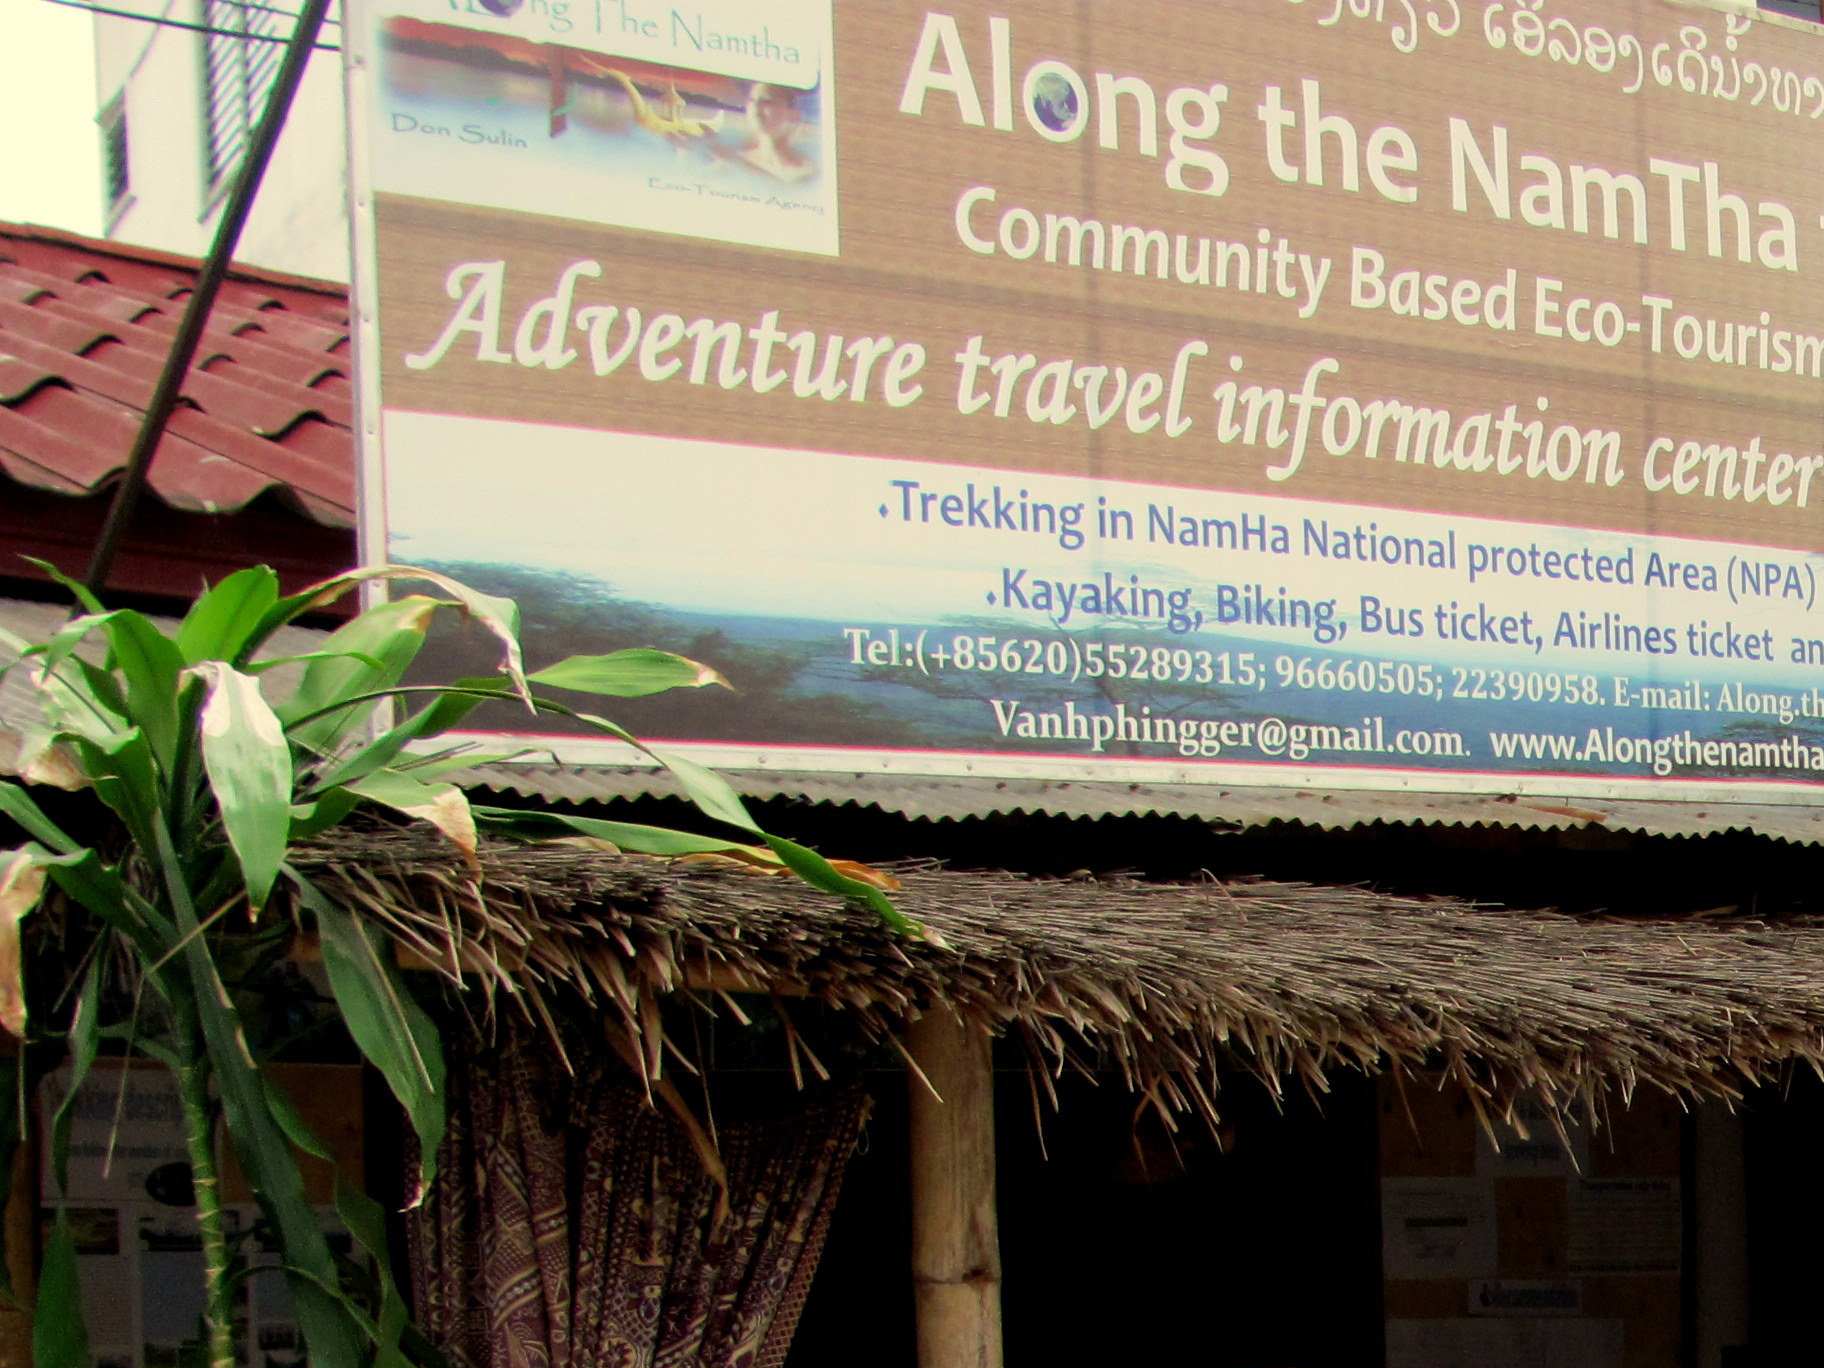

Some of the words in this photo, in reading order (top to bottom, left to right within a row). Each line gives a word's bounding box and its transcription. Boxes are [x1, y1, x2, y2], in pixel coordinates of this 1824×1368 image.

[670, 9, 800, 65] Namtha
[390, 112, 450, 137] Don
[458, 124, 529, 149] Sulin
[900, 11, 1230, 197] Along
[1258, 78, 1419, 203] the
[1449, 117, 1798, 272] NamTha
[955, 186, 1332, 319] Community
[1350, 246, 1517, 331] Based
[405, 259, 927, 408] Adventure
[954, 335, 1209, 438] travel
[1212, 354, 1624, 486] information
[1643, 435, 1824, 508] center
[1098, 497, 1134, 540] in
[1148, 502, 1290, 554] NamHa
[1302, 518, 1457, 570] National
[1468, 542, 1634, 585] protected
[1644, 552, 1718, 593] Area
[1727, 555, 1816, 611] (NPA)
[1001, 568, 1204, 635] Kayaking,
[1216, 584, 1348, 644] Biking,
[1360, 595, 1425, 638] Bus
[1435, 601, 1544, 654] ticket,
[1553, 610, 1678, 656] Airlines
[1686, 621, 1774, 661] ticket
[1275, 654, 1444, 702] 96660505;
[1452, 667, 1605, 707] 22390958.
[1613, 676, 1711, 712] E-mail:
